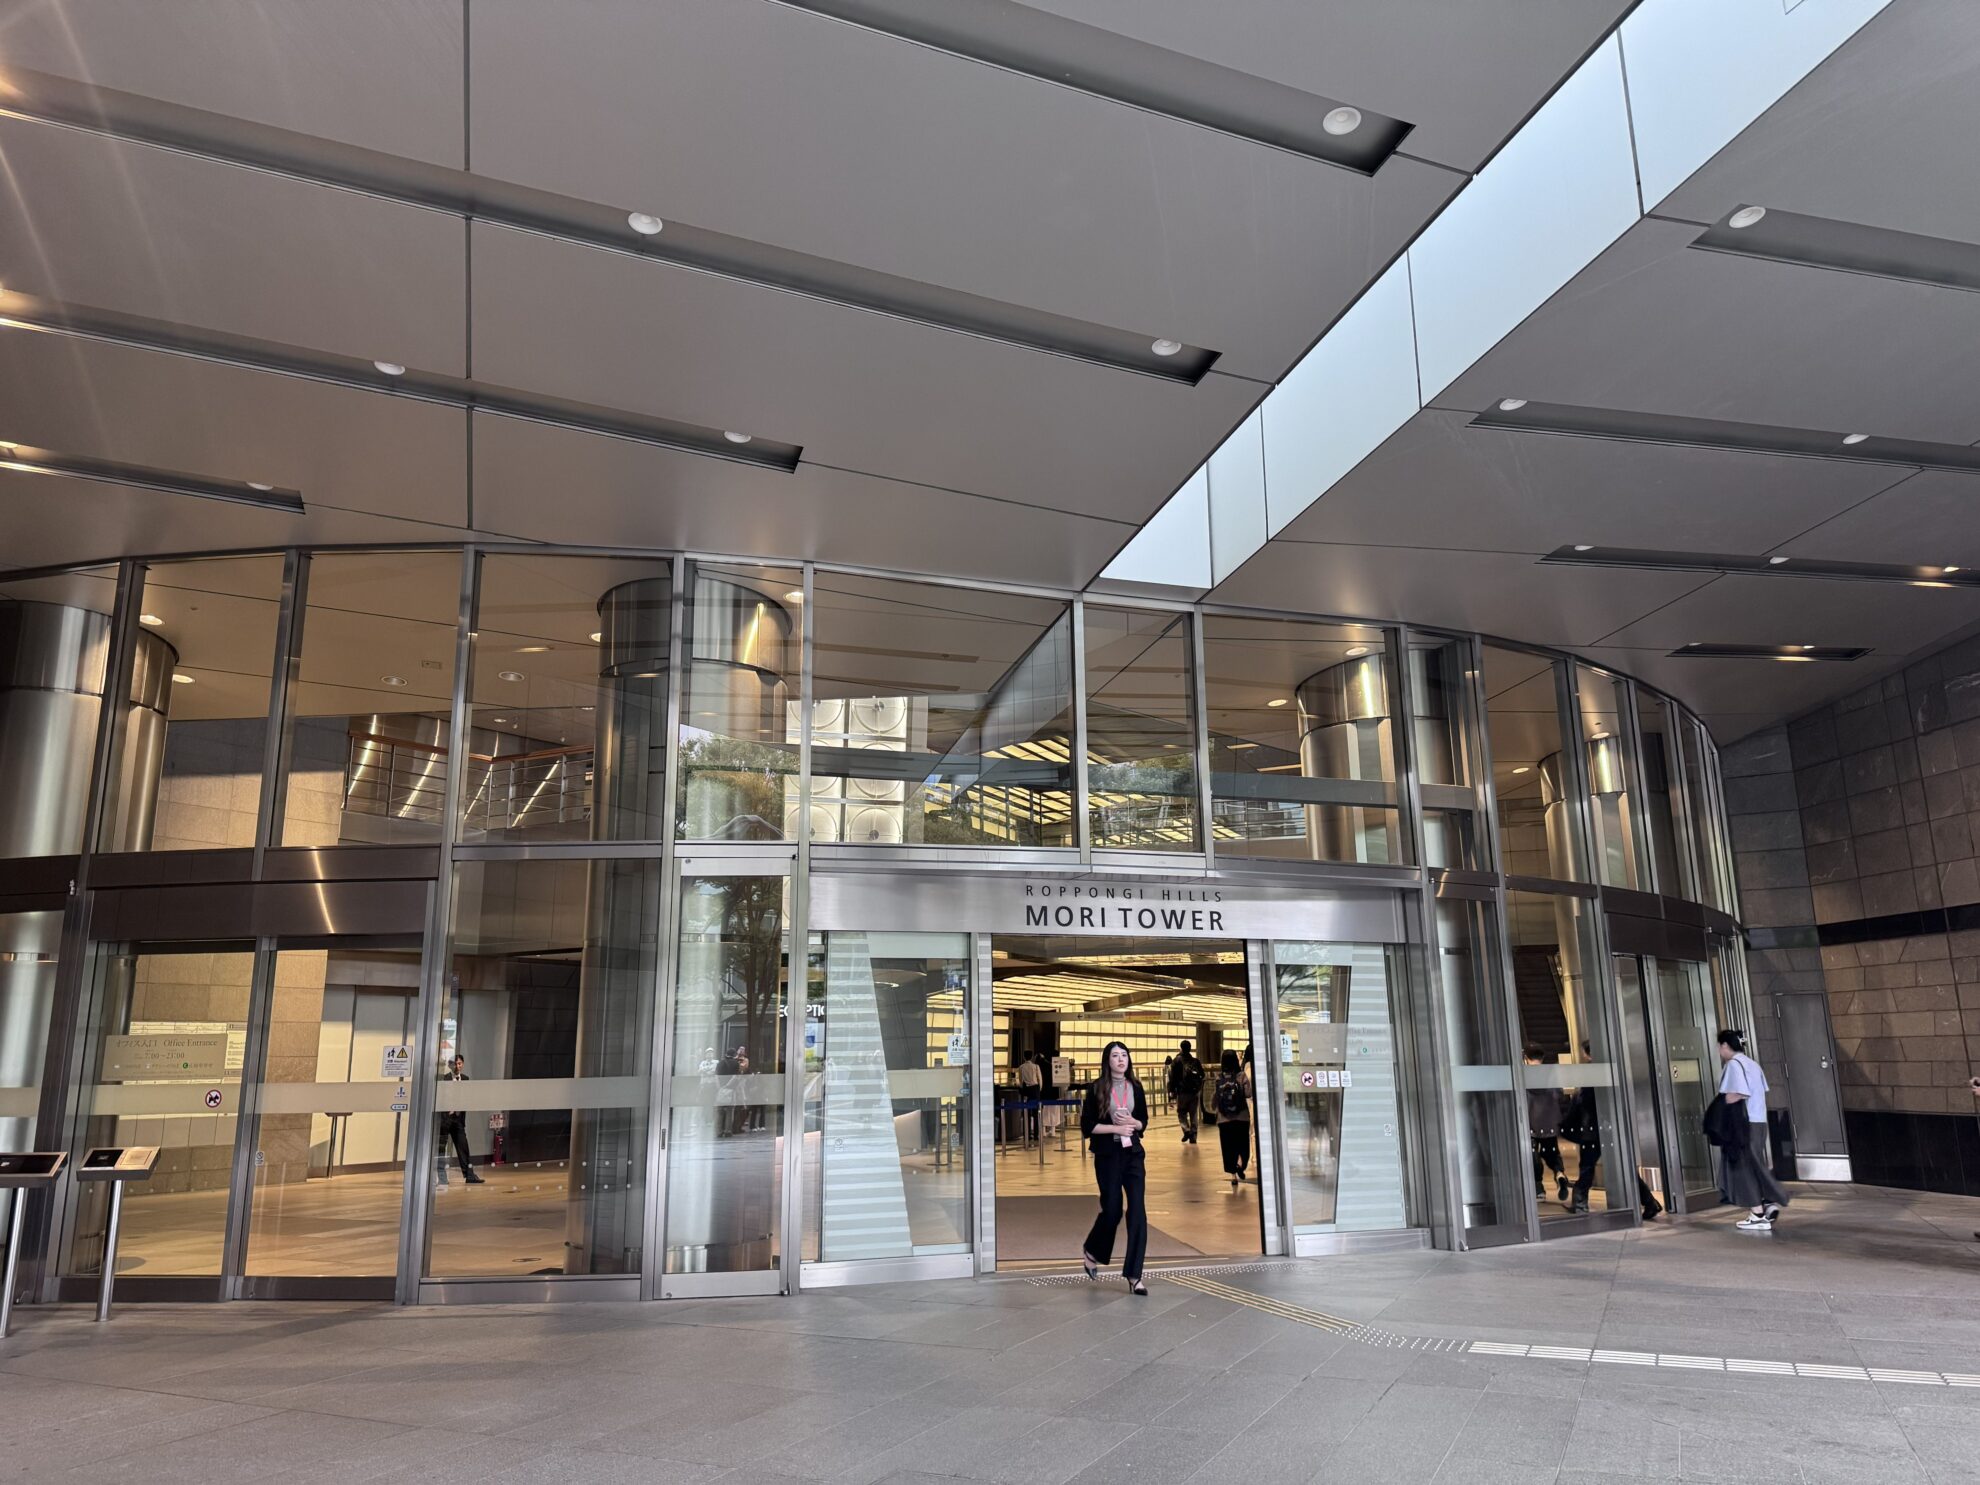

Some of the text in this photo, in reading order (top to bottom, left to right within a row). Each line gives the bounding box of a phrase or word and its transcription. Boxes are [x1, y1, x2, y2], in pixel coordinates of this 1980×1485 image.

[1026, 885, 1221, 903] ROPPONGI HILLS
[1026, 905, 1224, 931] MORI TOWER
[163, 1039, 185, 1047] Office
[187, 1039, 218, 1047] Entrance
